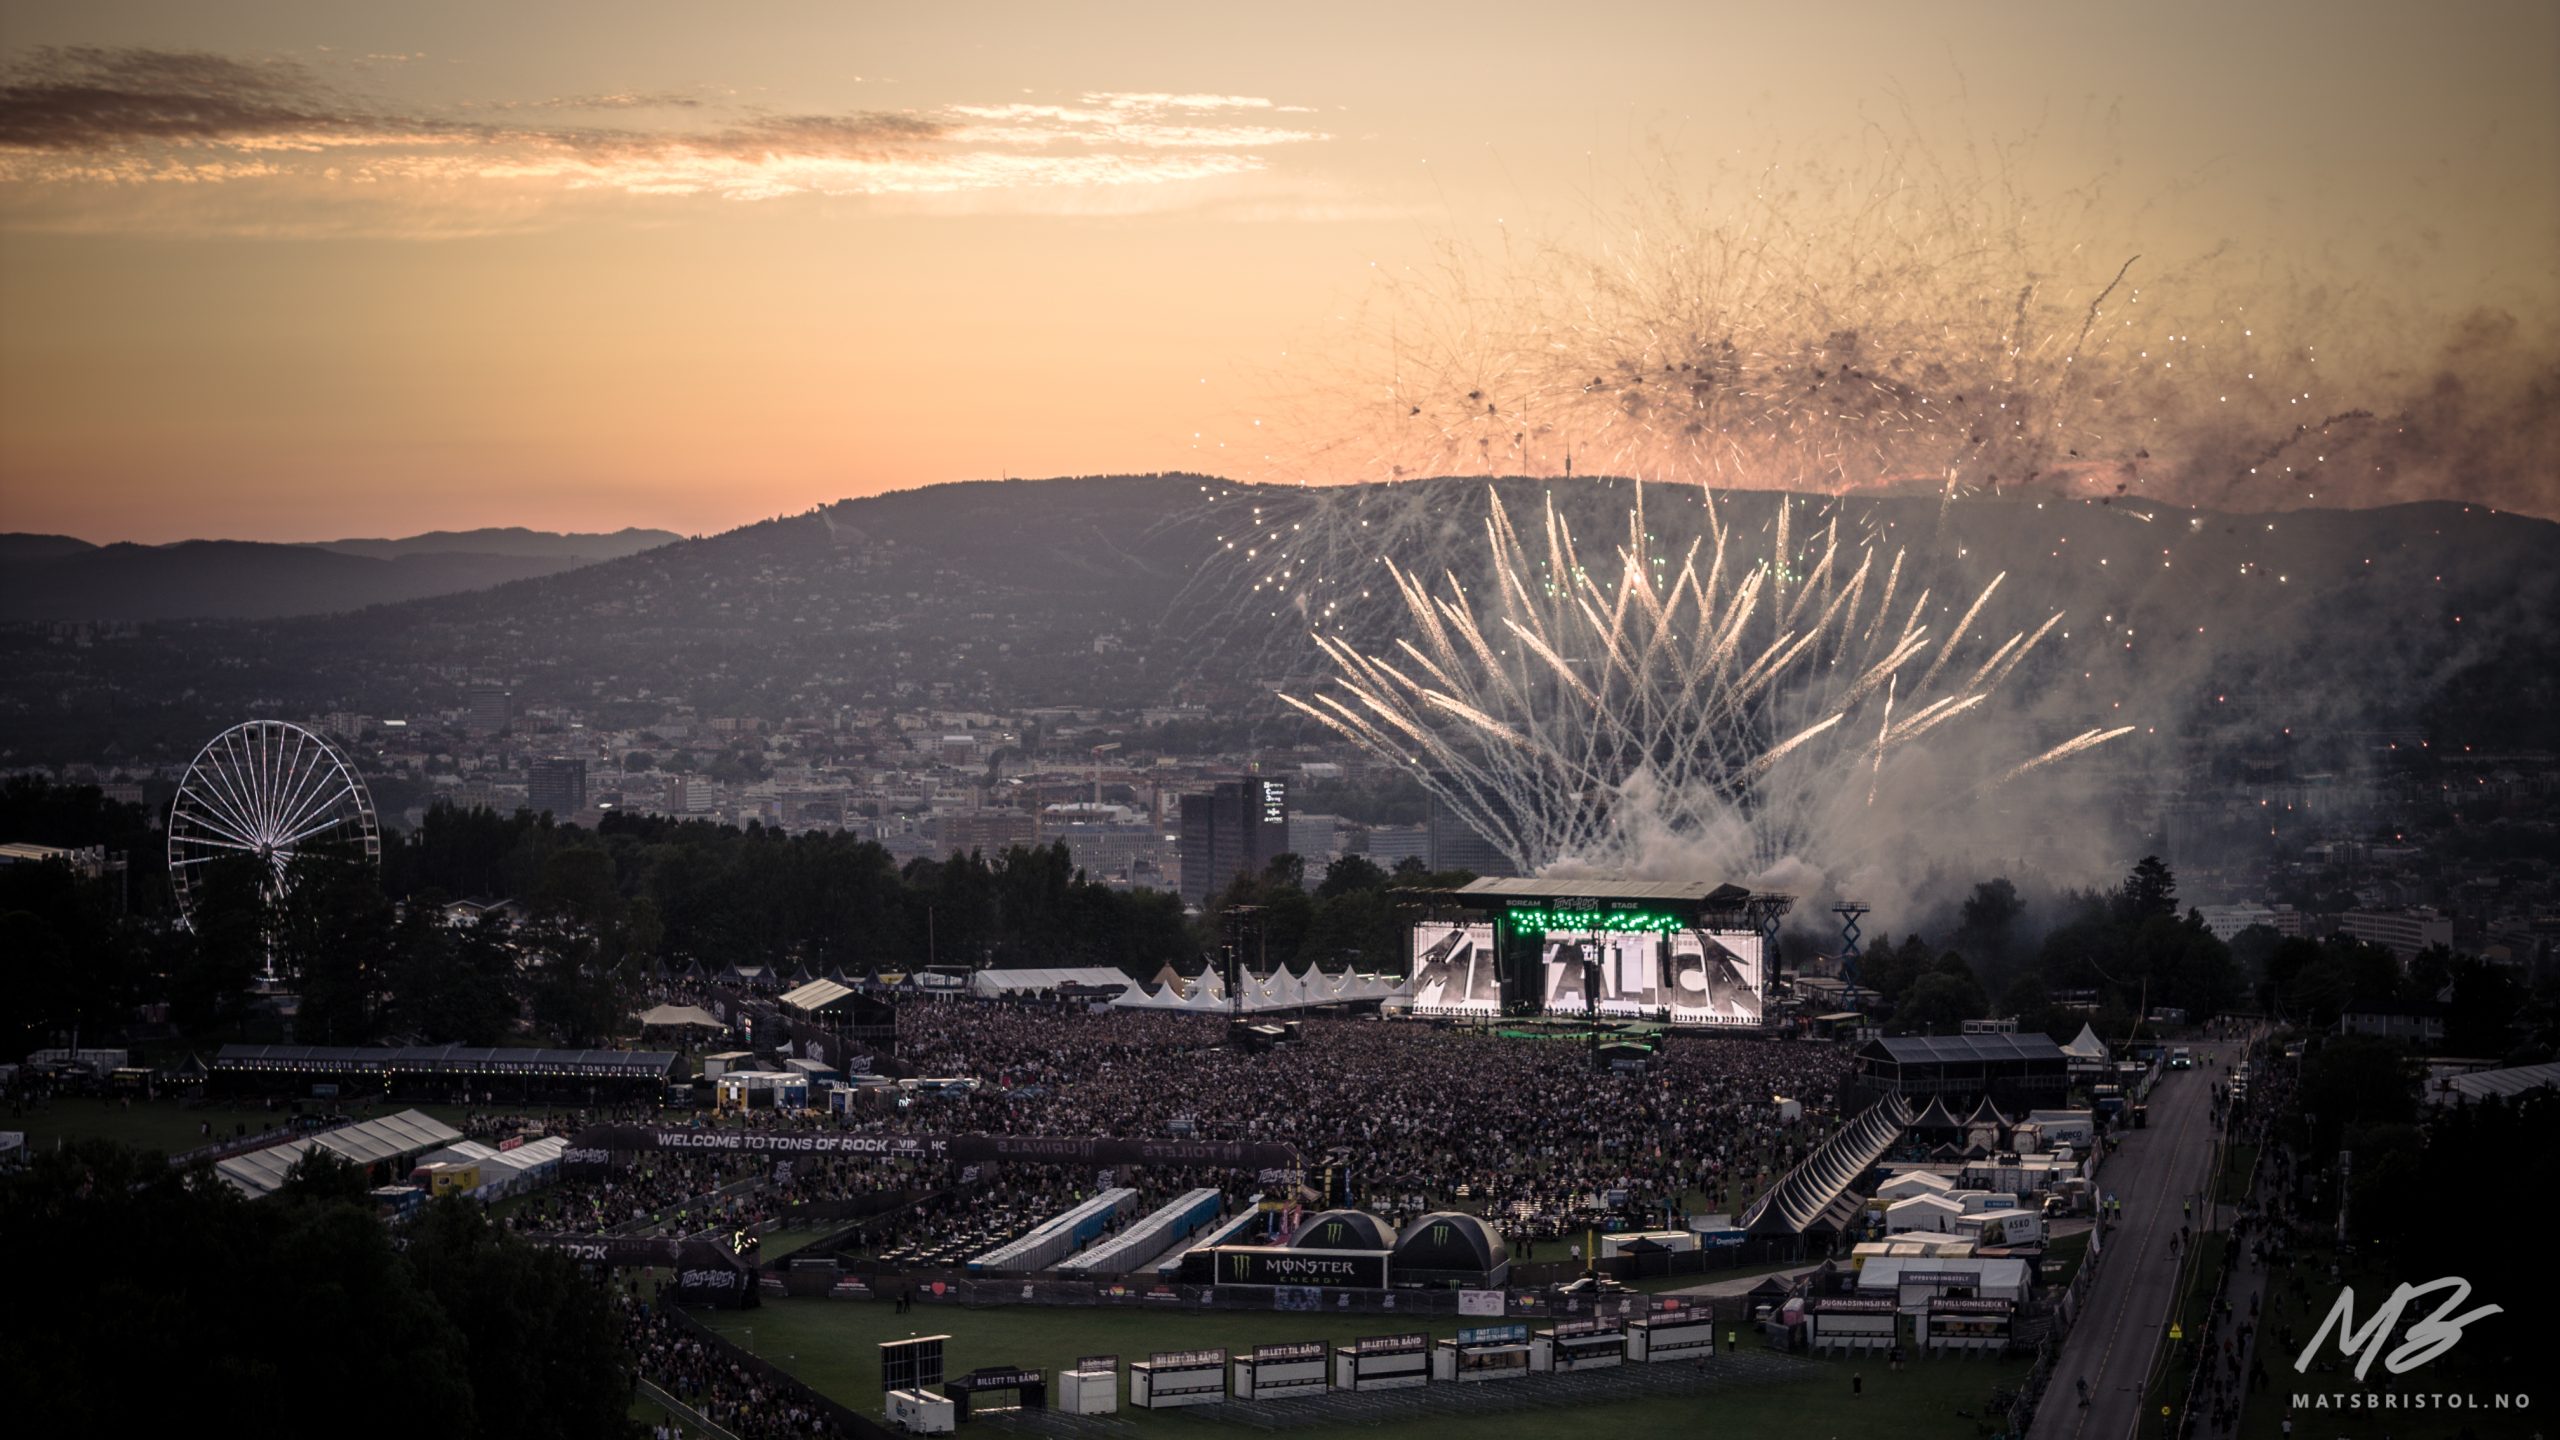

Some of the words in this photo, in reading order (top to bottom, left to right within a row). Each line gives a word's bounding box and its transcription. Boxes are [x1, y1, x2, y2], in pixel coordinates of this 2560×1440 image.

[1506, 899, 1541, 907] SCREAM
[2056, 1130, 2082, 1140] algeco
[658, 1133, 740, 1148] WELCOME
[744, 1137, 765, 1148] TO
[768, 1138, 812, 1150] TONS
[816, 1139, 836, 1150] OF
[841, 1139, 889, 1151] ROCK
[899, 1140, 917, 1149] VIP
[932, 1141, 946, 1150] HC
[2008, 1219, 2030, 1230] ASKO
[1266, 1258, 1355, 1274] MONSTER
[1280, 1276, 1341, 1284] ENERGY
[1821, 1299, 1892, 1308] DUGNADSINNSJEKK
[1362, 1339, 1389, 1348] BILLETT
[1390, 1338, 1399, 1346] TIL
[1401, 1336, 1421, 1345] BÅND
[1259, 1348, 1287, 1356] BILLETT
[1288, 1347, 1298, 1355] TIL
[1300, 1344, 1320, 1354] BÅND
[1155, 1355, 1183, 1365] BILLETT
[1184, 1354, 1196, 1363] TIL
[1198, 1352, 1219, 1363] BÅND
[977, 1375, 1004, 1386] BILLETT
[1005, 1375, 1017, 1384] TIL
[1018, 1373, 1039, 1384] BÅND
